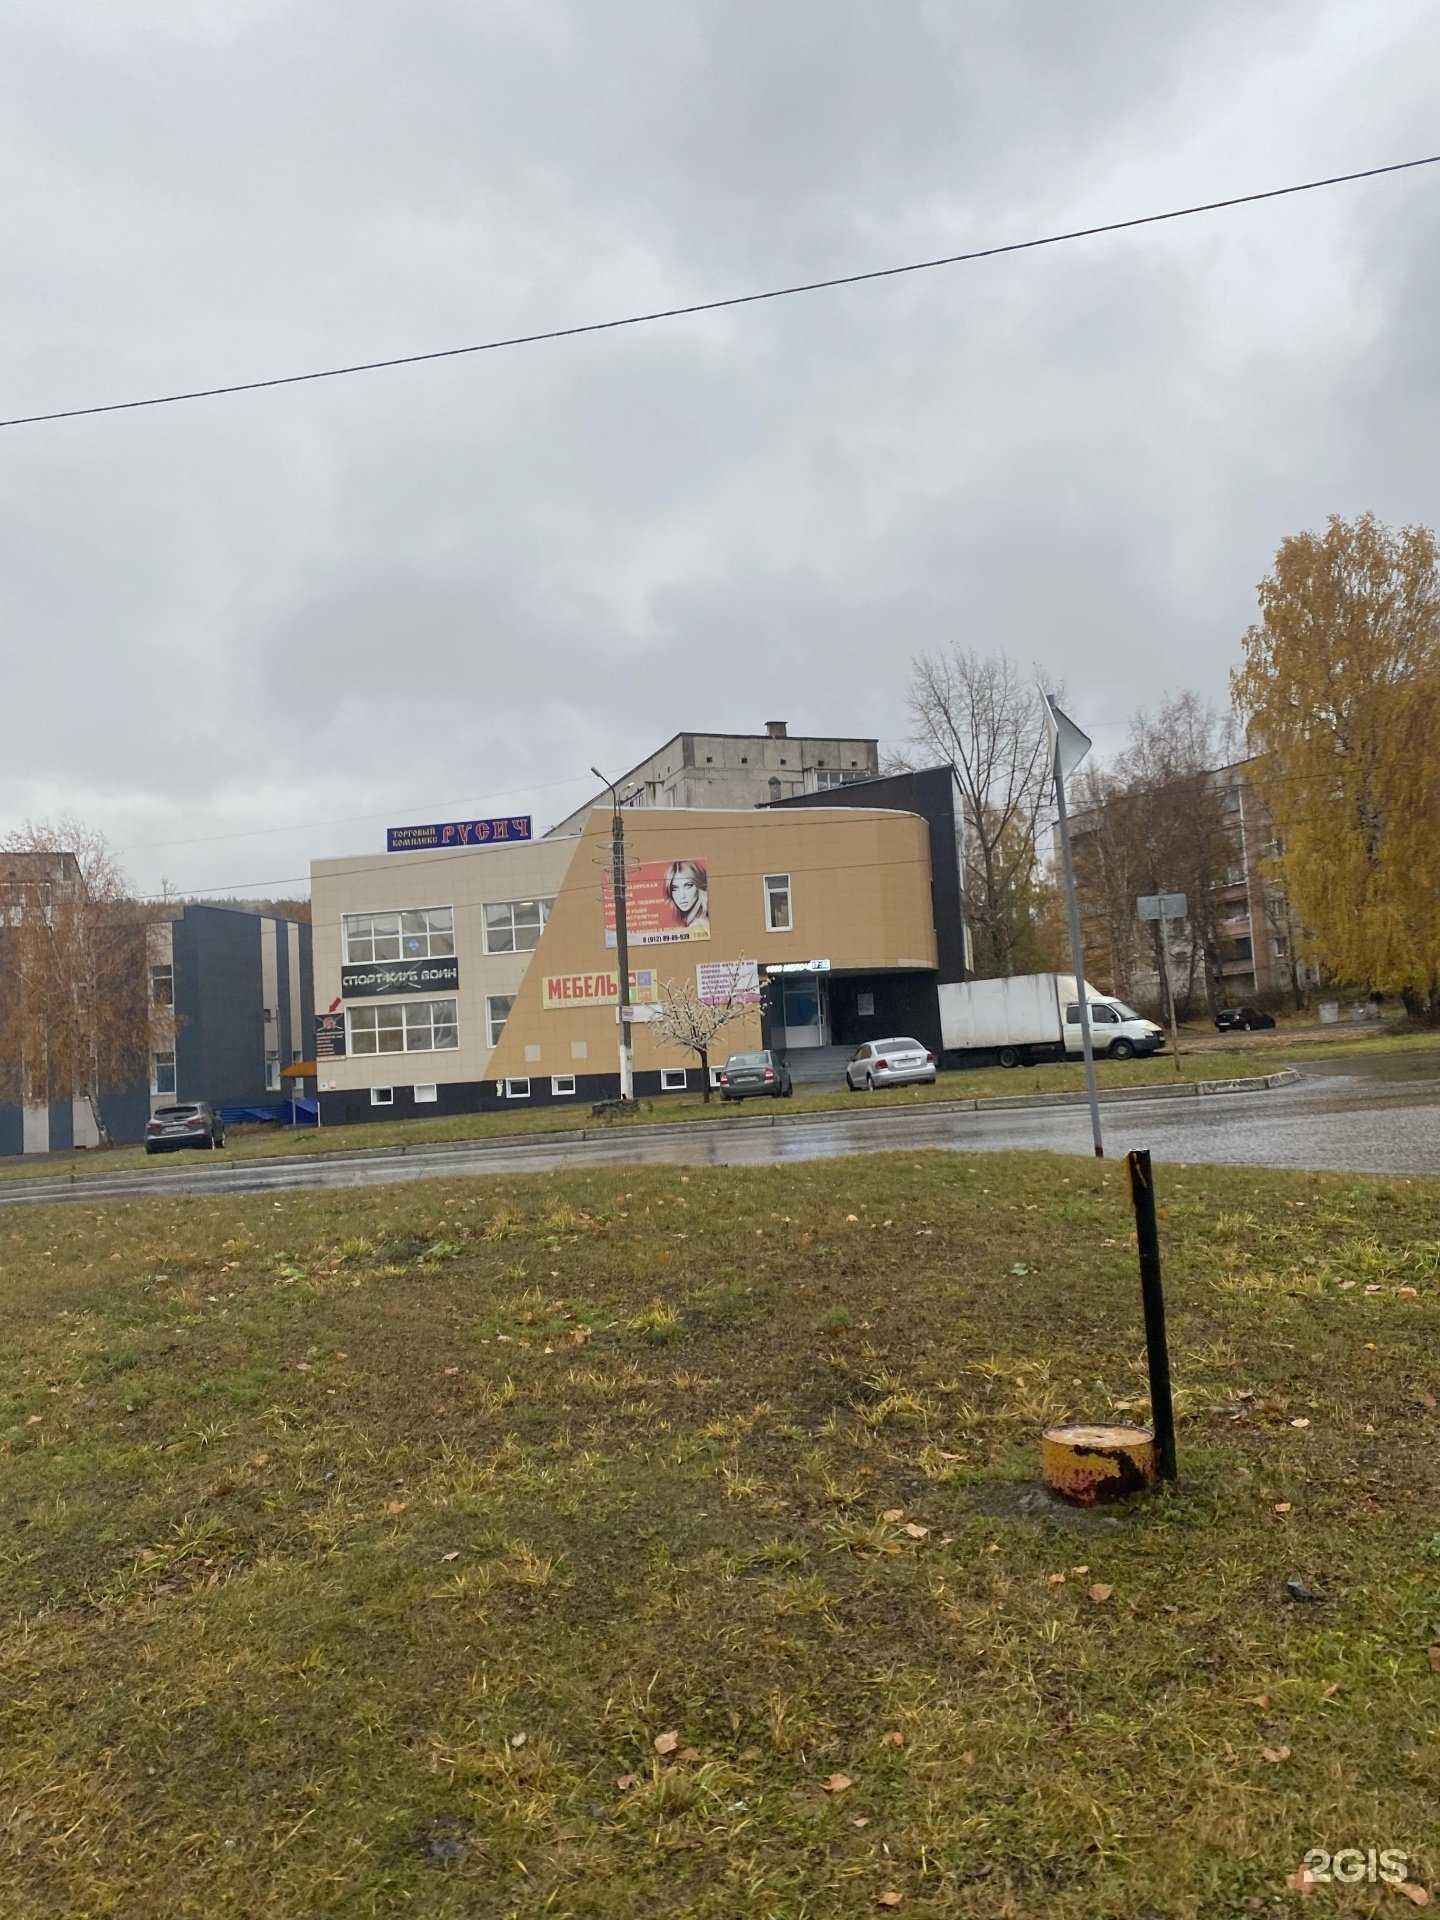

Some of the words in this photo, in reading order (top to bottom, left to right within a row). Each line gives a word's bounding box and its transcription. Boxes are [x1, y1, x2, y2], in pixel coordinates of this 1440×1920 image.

[393, 828, 436, 839] ТОРГОВЫЙ
[442, 819, 529, 845] РУСИЧ
[392, 836, 438, 848] КОМПЛЕКС
[547, 974, 618, 1000] МЕБЕЛЬ
